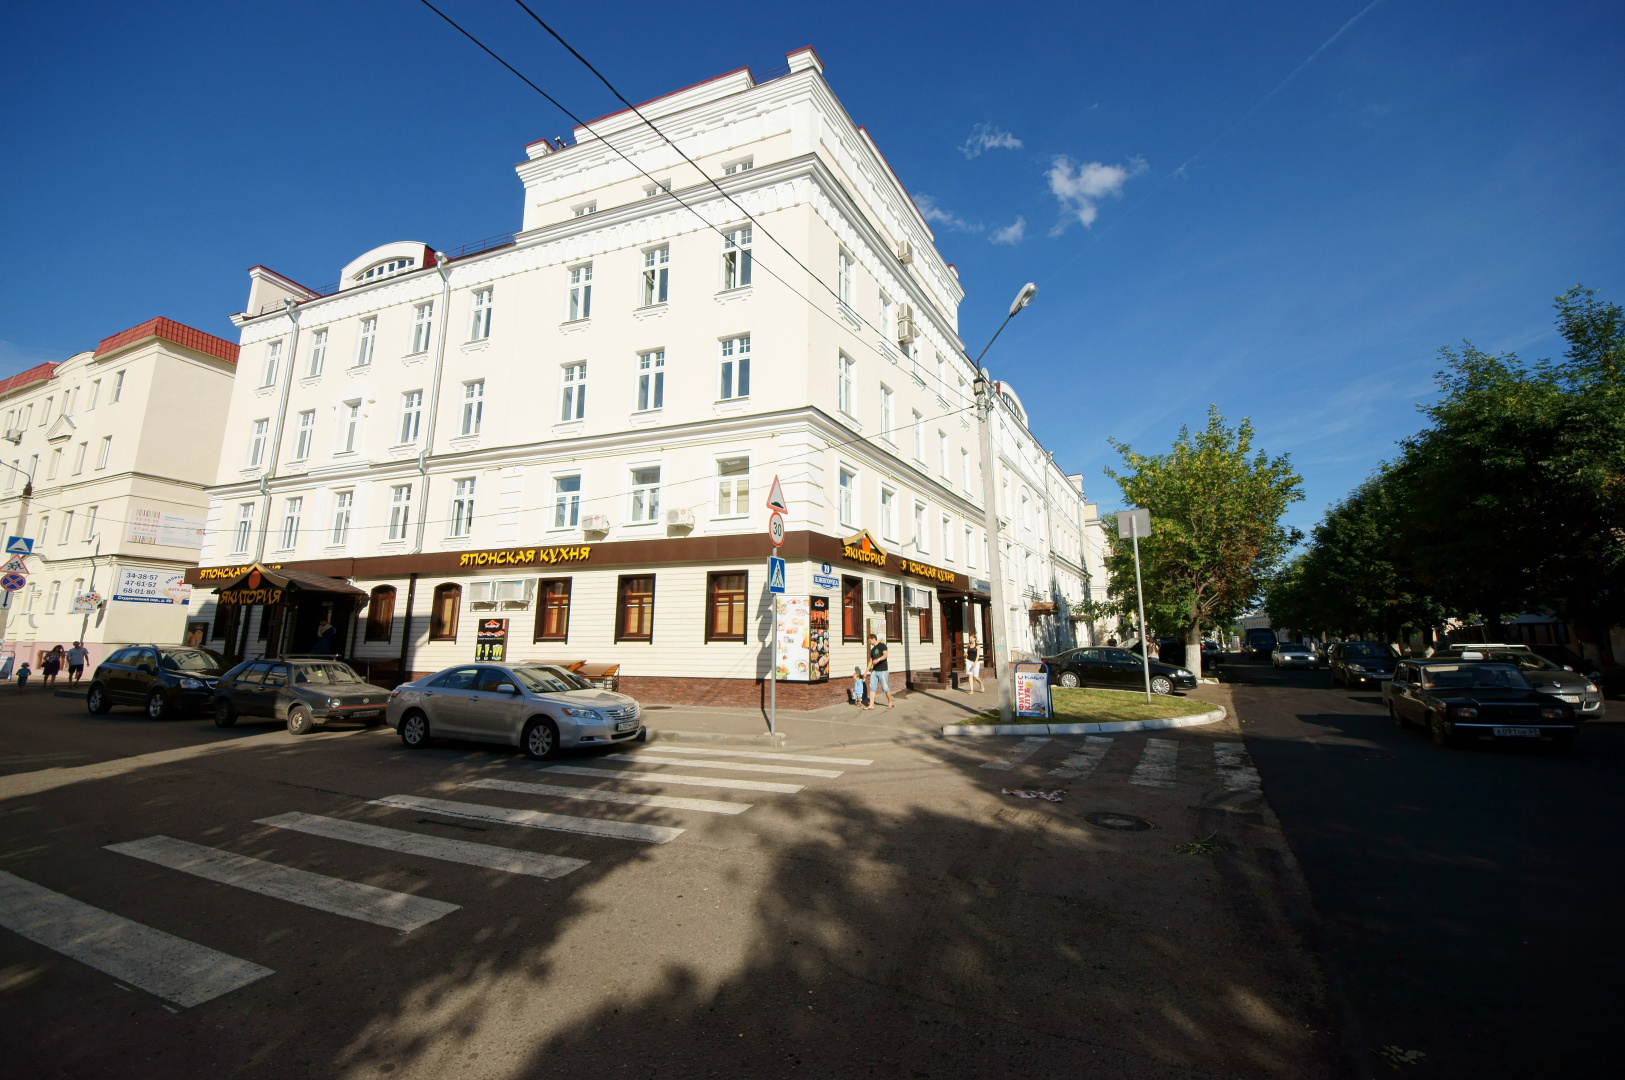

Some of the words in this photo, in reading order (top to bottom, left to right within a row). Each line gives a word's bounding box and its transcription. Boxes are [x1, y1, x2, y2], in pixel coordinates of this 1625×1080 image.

[773, 522, 781, 536] 30
[460, 550, 535, 566] ЯПОНСКАЯ
[539, 547, 590, 564] КУХНЯ
[844, 546, 886, 565] ЯКИТОРИЯ
[824, 564, 830, 574] 19
[937, 570, 955, 583] КУХНЯ
[220, 589, 282, 605] ЯКИТОРИЯ
